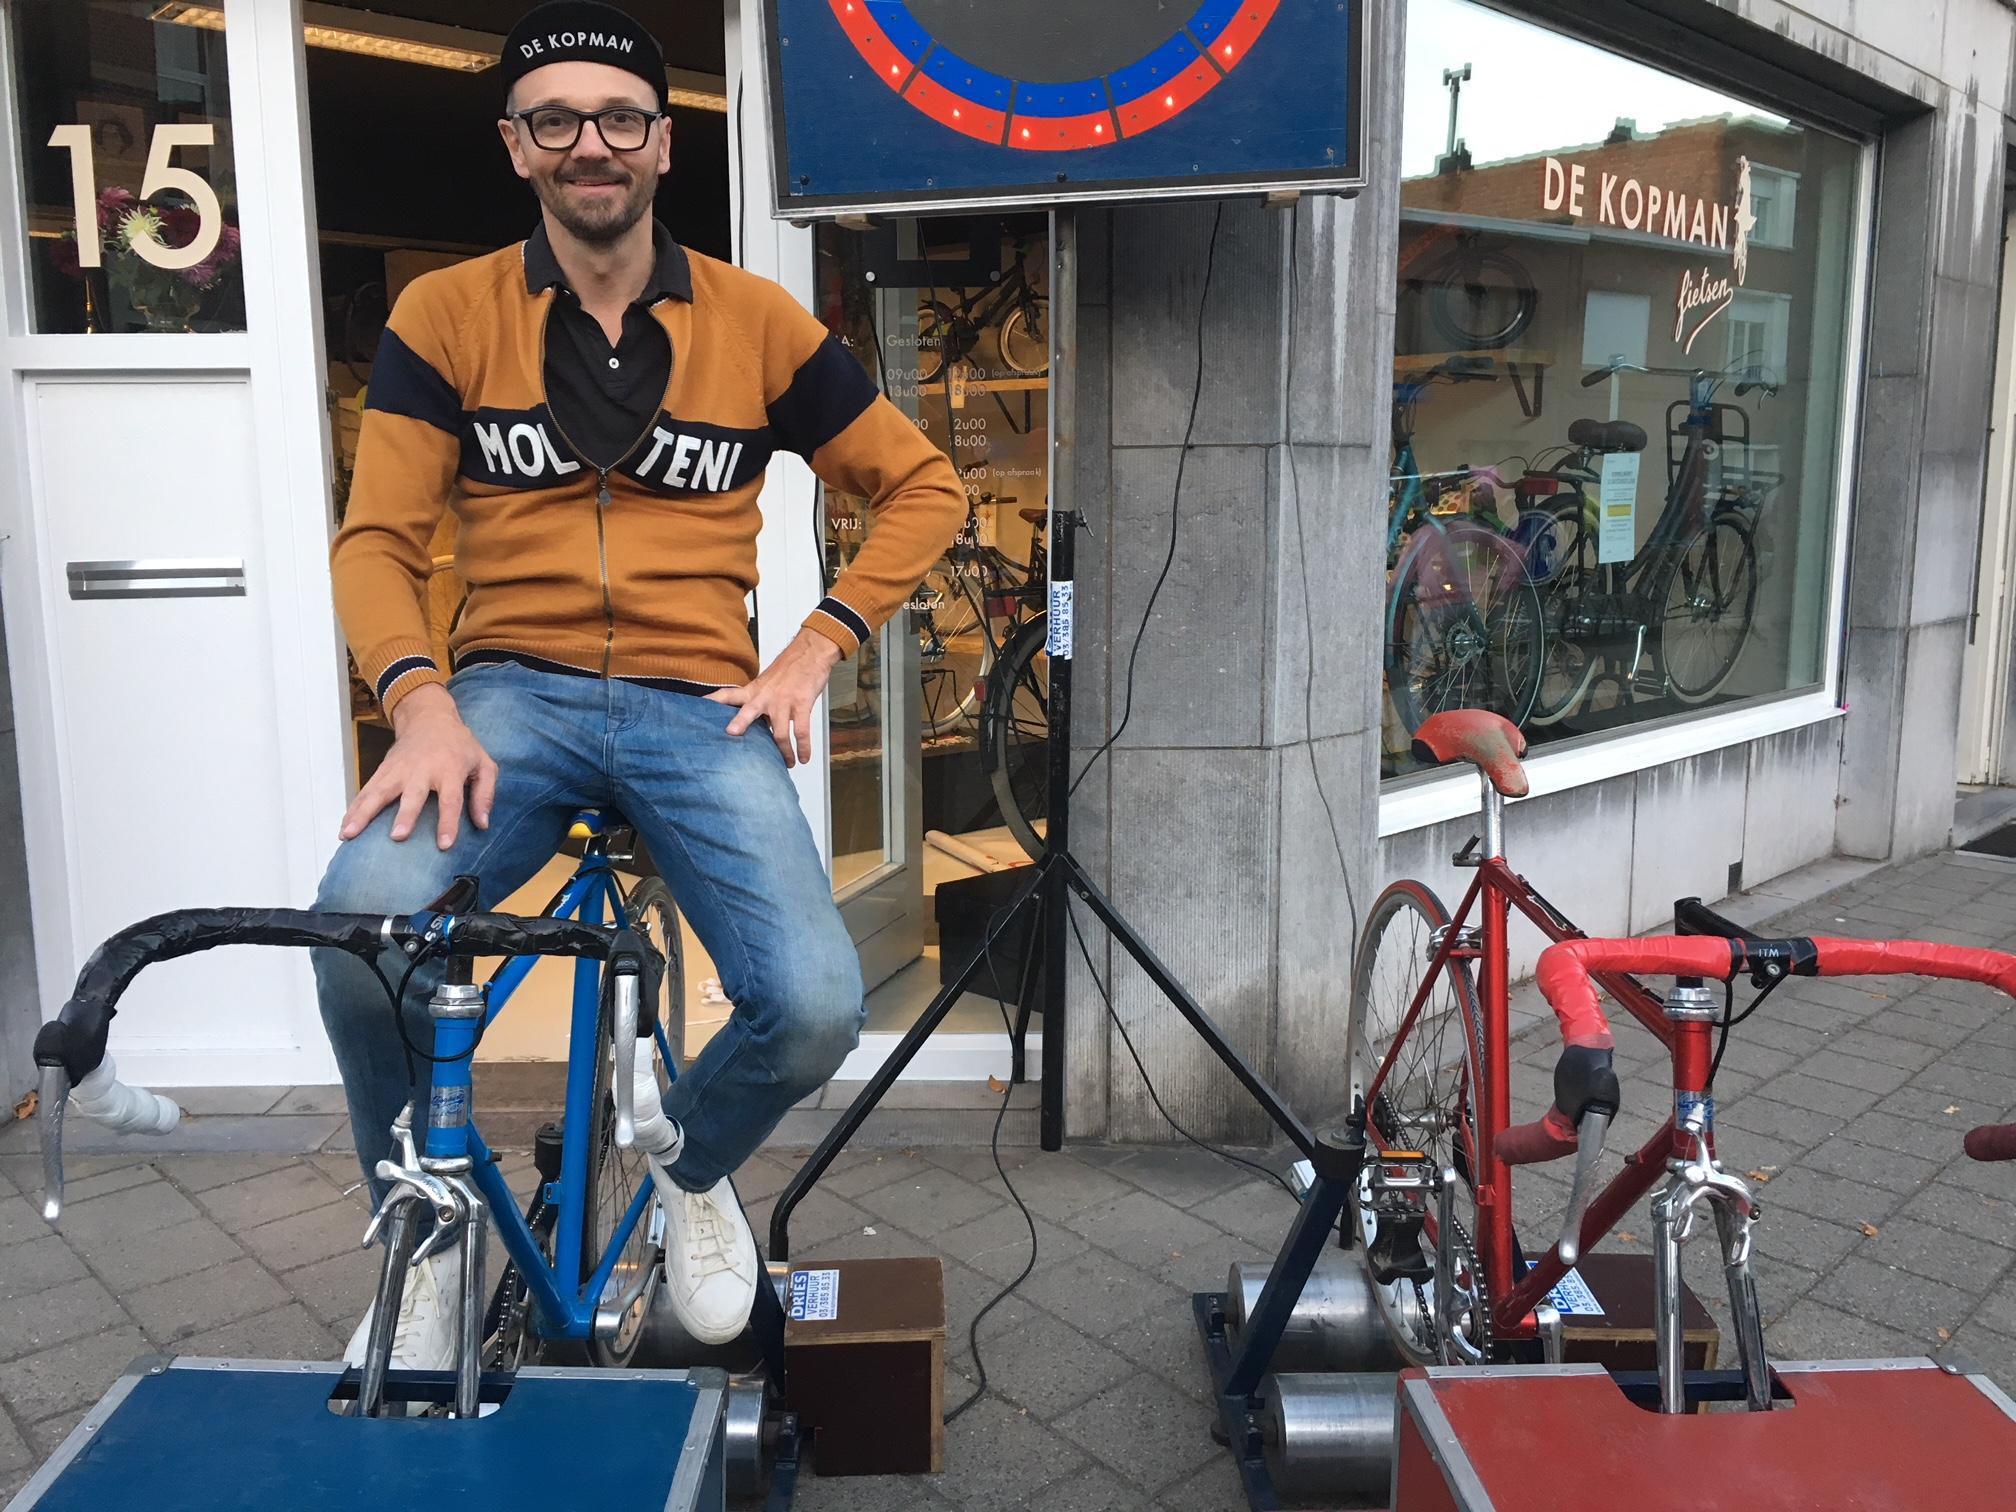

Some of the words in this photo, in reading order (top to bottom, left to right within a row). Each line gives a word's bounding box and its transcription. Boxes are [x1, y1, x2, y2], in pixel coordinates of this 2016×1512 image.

[519, 38, 544, 59] DE
[548, 31, 634, 53] KOPMAN
[47, 123, 222, 269] 15
[1543, 157, 1585, 217] DE
[1599, 172, 1729, 250] KOPMAN
[1674, 266, 1734, 354] fietsen
[835, 335, 854, 347] A:
[886, 333, 941, 347] Gesloten
[886, 368, 928, 380] 09u00
[953, 418, 987, 430] 2u00
[473, 423, 580, 477] MOL
[635, 426, 743, 492] TENI
[831, 518, 862, 530] VRIJ:
[902, 597, 945, 610] esloten
[1053, 590, 1061, 652] VERHUUR
[1758, 948, 1780, 958] ITM
[791, 1275, 808, 1317] DRIES
[807, 1275, 820, 1315] VERHUUR
